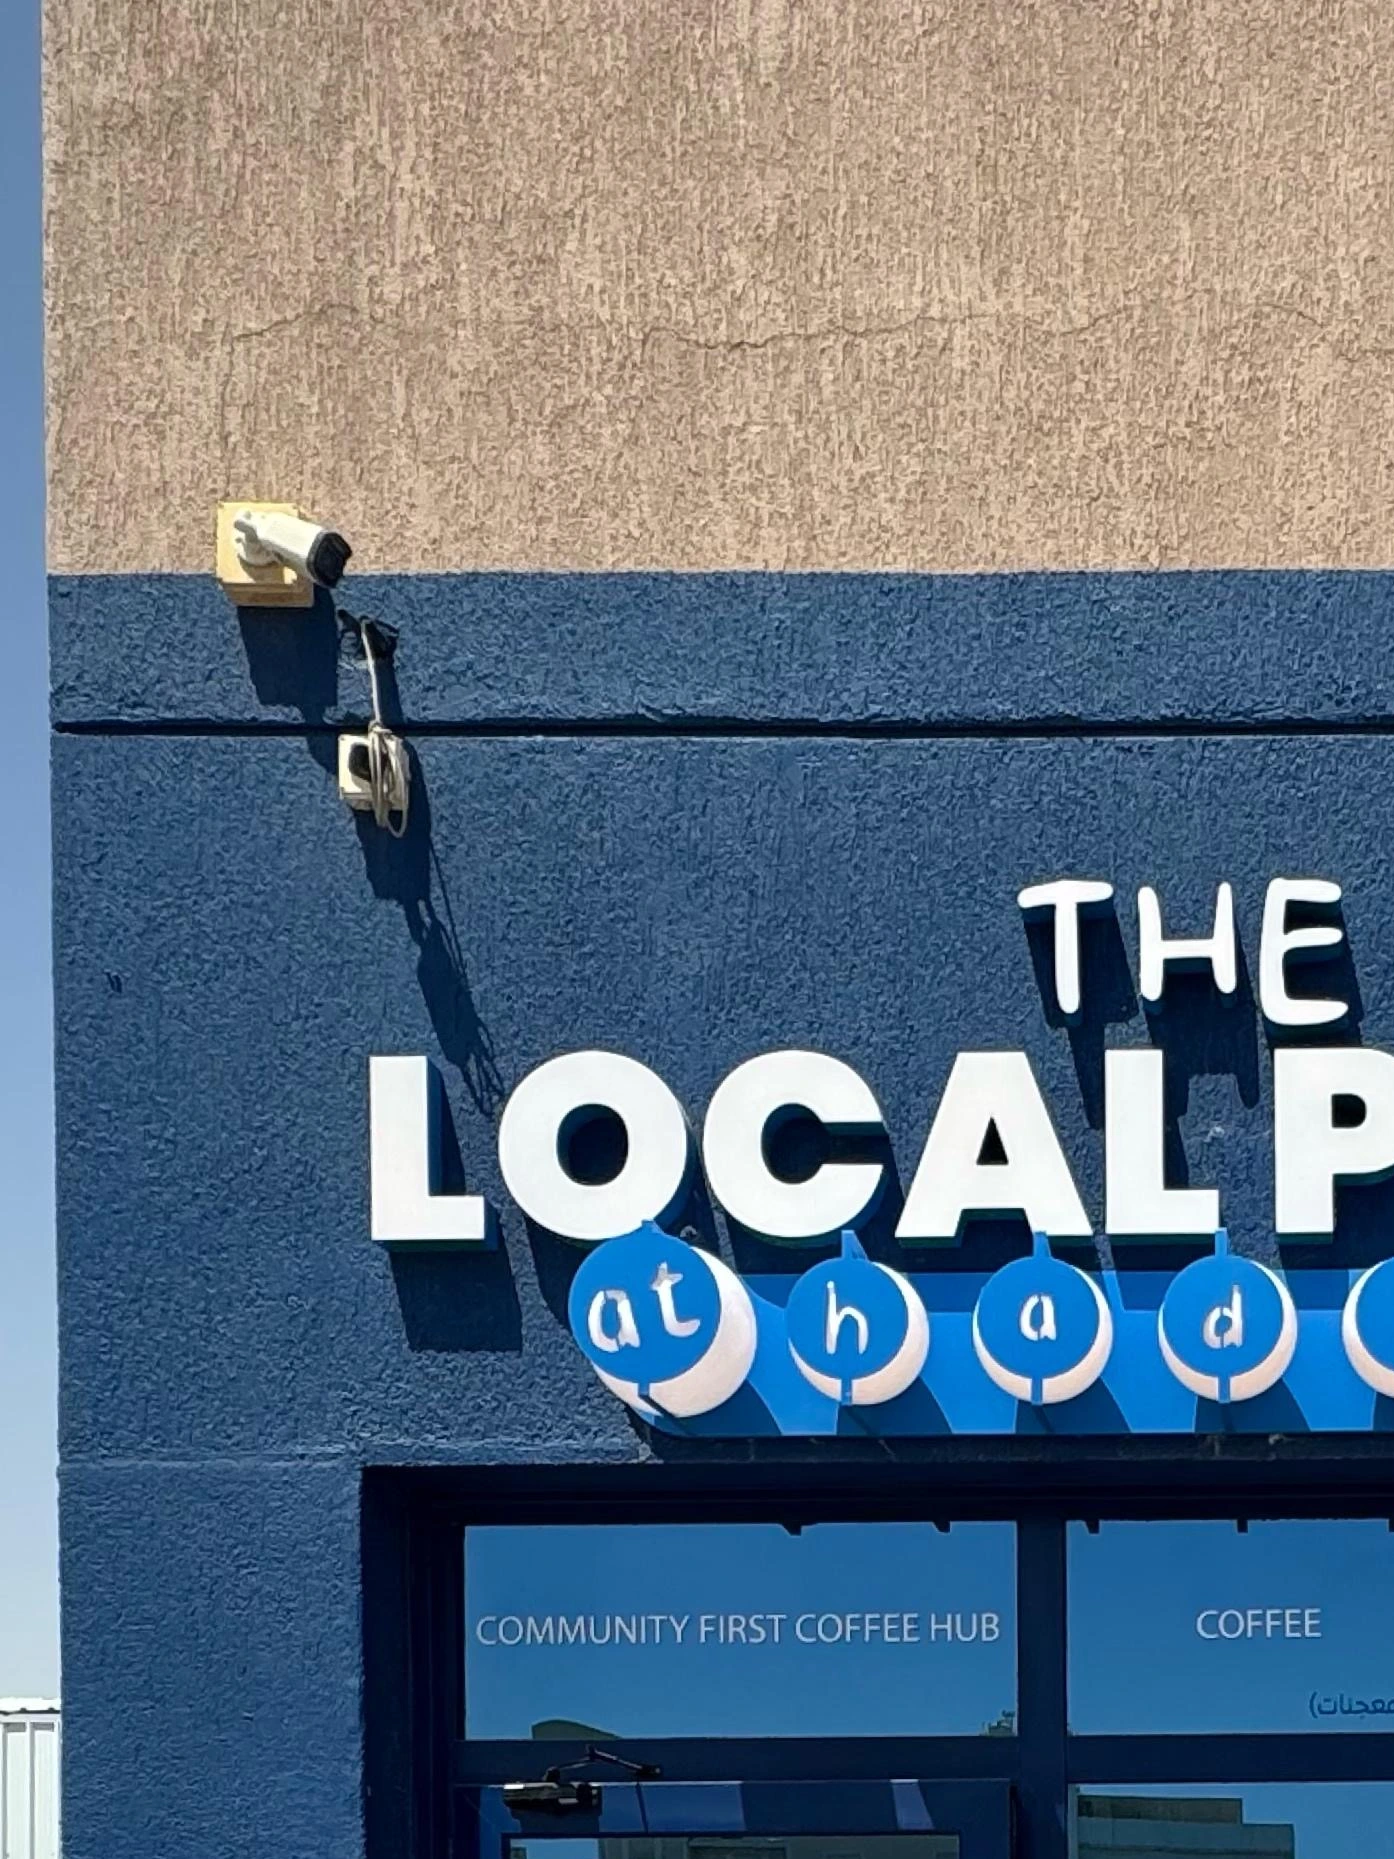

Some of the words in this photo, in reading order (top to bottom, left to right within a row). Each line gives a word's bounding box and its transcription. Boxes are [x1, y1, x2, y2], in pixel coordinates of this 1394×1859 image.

[1018, 877, 1349, 1028] THE
[367, 1048, 1220, 1243] LOCAL
[475, 1613, 690, 1647] COMMUNITY
[699, 1613, 788, 1645] FIRST
[794, 1612, 921, 1644] COFFEE
[930, 1611, 1001, 1643] HUB
[1195, 1607, 1322, 1641] COFFEE
